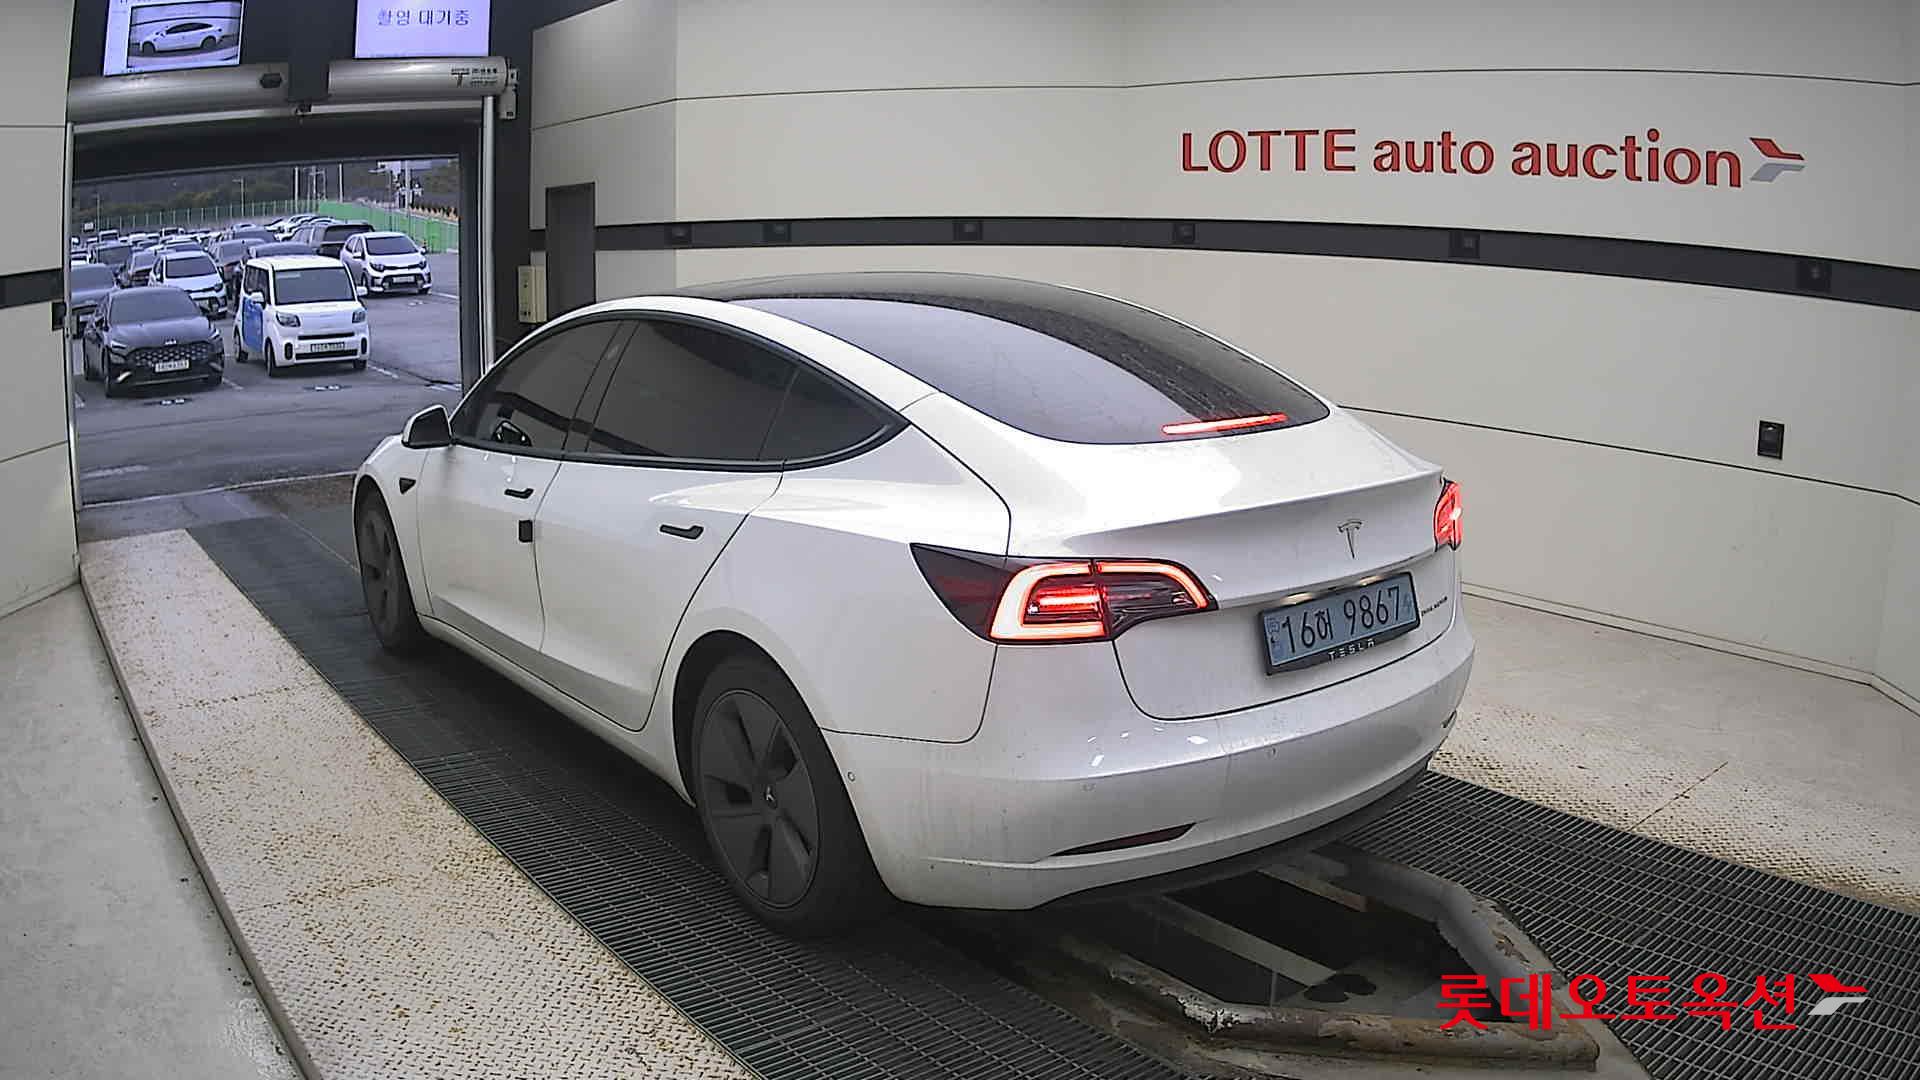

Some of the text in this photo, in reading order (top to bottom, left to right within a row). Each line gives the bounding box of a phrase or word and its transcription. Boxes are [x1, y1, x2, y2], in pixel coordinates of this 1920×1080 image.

[419, 9, 469, 26] 대기중
[1181, 128, 1743, 189] LOTTE auto auction
[1281, 608, 1334, 653] 16허
[1343, 586, 1400, 636] 9867
[1328, 637, 1376, 660] TESLA
